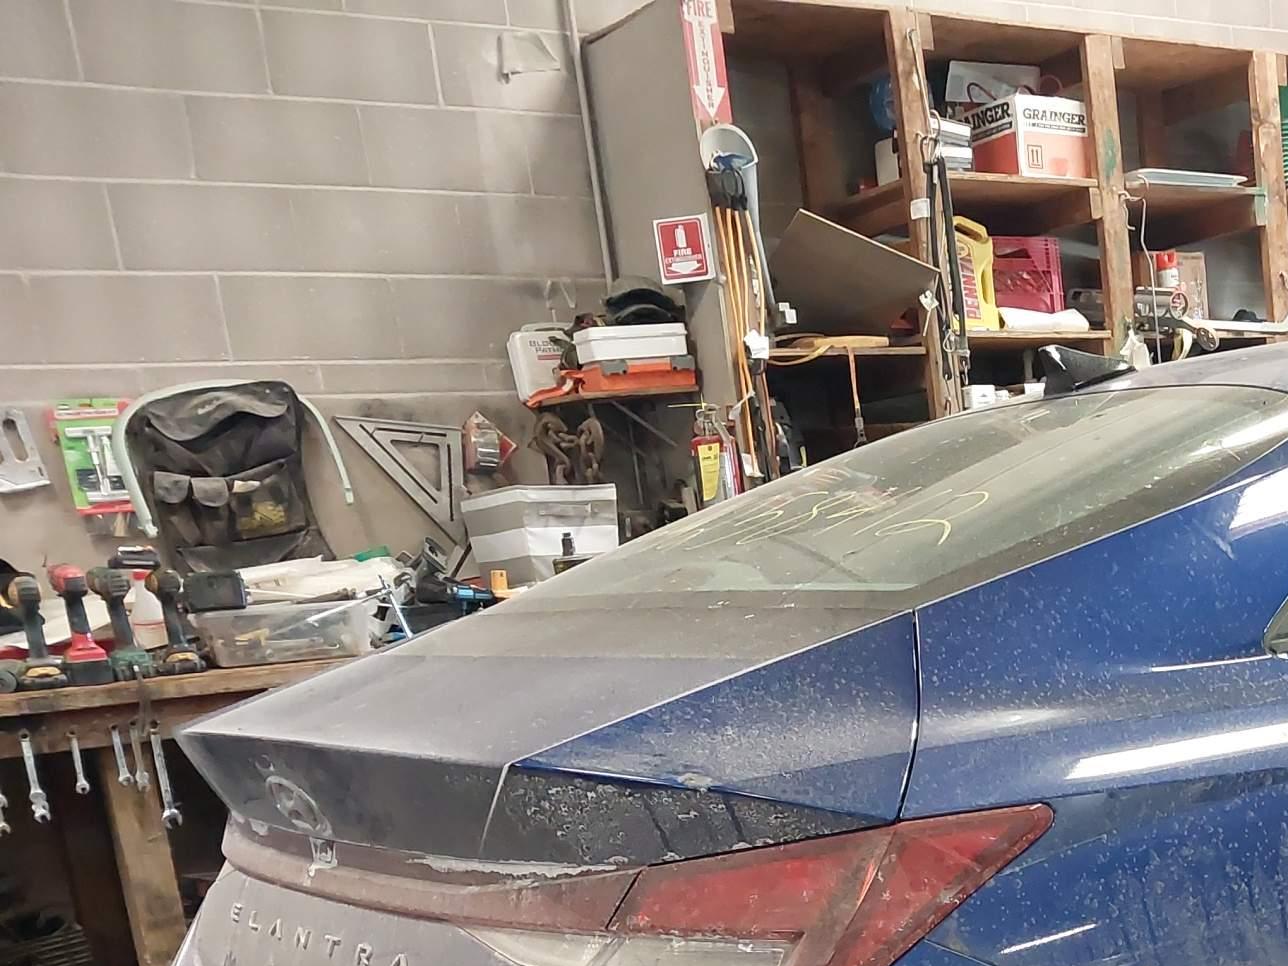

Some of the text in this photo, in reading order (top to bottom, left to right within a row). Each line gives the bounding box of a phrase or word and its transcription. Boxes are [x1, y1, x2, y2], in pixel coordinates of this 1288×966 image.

[686, 0, 713, 18] FIRE
[1022, 107, 1086, 126] GRAINGER
[672, 247, 692, 257] FIRE
